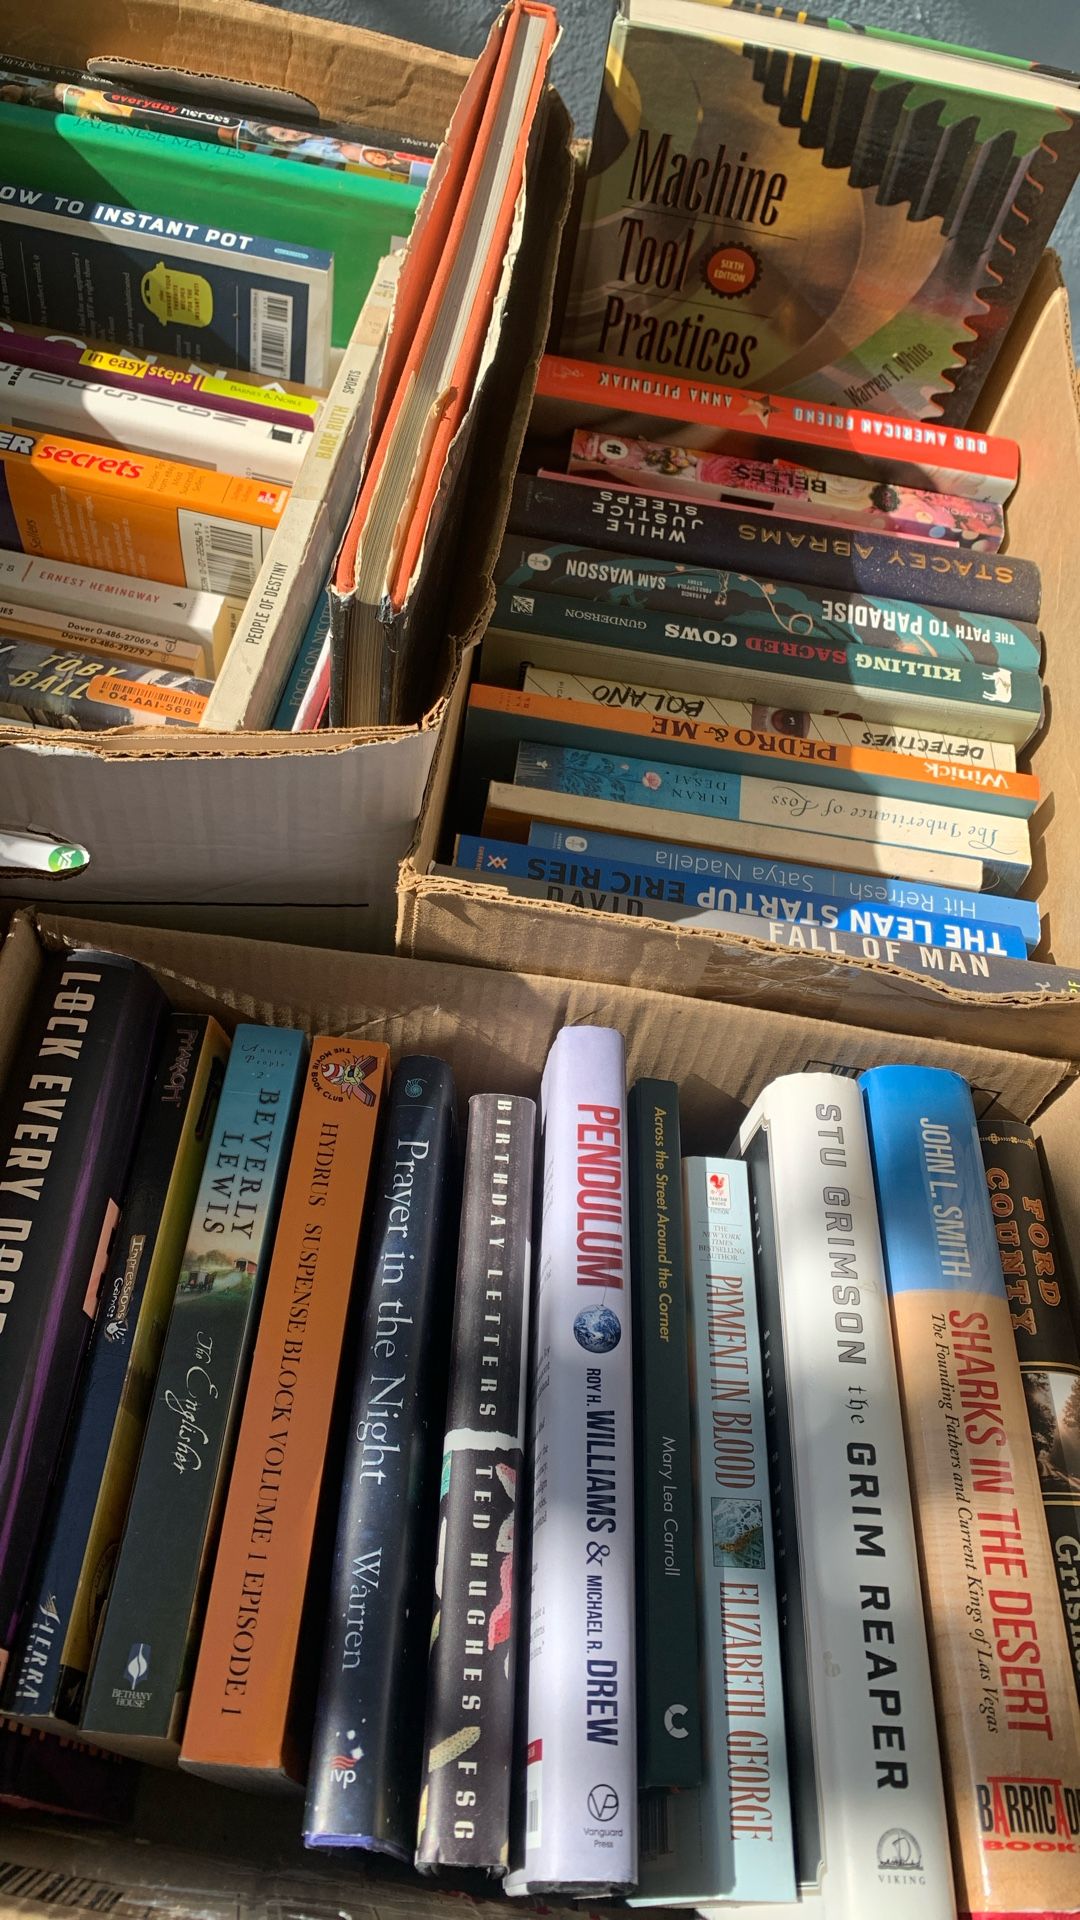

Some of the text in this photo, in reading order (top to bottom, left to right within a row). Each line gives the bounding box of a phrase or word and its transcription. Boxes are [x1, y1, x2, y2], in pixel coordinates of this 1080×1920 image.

[74, 116, 247, 160] JAPANESE MAPLES
[111, 93, 230, 124] everyday heroes
[627, 128, 788, 227] Machine
[0, 186, 253, 250] OW TO INSTANT POT
[616, 216, 695, 292] Tool
[713, 268, 746, 284] EDITION
[720, 258, 744, 272] SIXTH
[598, 294, 759, 380] Practices
[88, 352, 194, 385] in easy steps
[342, 369, 362, 395] SPORTS
[315, 405, 349, 461] BABE RUTH
[599, 372, 988, 454] OUR AMERICAN FRIEND ANNA PITONIAK
[38, 444, 145, 480] secrets
[731, 463, 826, 494] BELLES
[592, 502, 704, 530] JUSTICE
[599, 491, 698, 516] SLEEPS
[607, 519, 687, 544] WHILE
[566, 559, 667, 590] SAM WASSON
[738, 524, 1014, 584] STACEY ABRAMS
[39, 571, 161, 603] ERNEST HEMINGWAY
[245, 562, 288, 645] PEOPLE OF DESTINY
[67, 621, 160, 648] Dover 0-486-27069-6
[565, 608, 962, 683] KILLING SACRED COWS GUNDERSON
[821, 600, 1015, 645] THE PATH TO PARADISE
[9, 670, 89, 700] BALL
[38, 654, 127, 677] TOBY
[650, 715, 1009, 790] Winick PEDRO & ME
[861, 732, 985, 760] DETECTIVES
[672, 788, 728, 805] KIRAN
[675, 775, 728, 791] DESAI
[771, 786, 1018, 855] The Inheritance of Loss
[527, 858, 1007, 956] THE LEAN STARTUP ERIC RIES
[546, 885, 644, 917] DAVID
[655, 850, 976, 918] Hit Refresh Satya Nadella
[769, 922, 990, 978] FALL OF MAN
[0, 971, 101, 1201] LOCK EVERY
[244, 1055, 286, 1068] People
[202, 1131, 245, 1235] LEWIS
[230, 1087, 281, 1240] BEVERLY
[308, 1122, 340, 1208] HYDRUS
[576, 1104, 624, 1290] PENDULUM
[653, 1106, 672, 1343] Across the Street Around the Corner
[920, 1118, 972, 1278] JOHN L. SMITH
[698, 1244, 745, 1255] BESTSELLING
[707, 1253, 738, 1261] AUTHOR
[985, 1168, 1037, 1336] COUNTY
[1023, 1197, 1061, 1306] FORD
[291, 1222, 323, 1340] SUSPENSE
[272, 1340, 303, 1422] BLOCK
[342, 1138, 430, 1672] Prayer in the Night Warren
[705, 1273, 757, 1490] PAYMENT IN BLOOD
[454, 1099, 513, 1840] BIRTHDAY LETTERS TED HUGHES FSG
[814, 1103, 910, 1791] STU GRIMSON the GRIM REAPER
[250, 1430, 289, 1544] VOLUME
[658, 1436, 681, 1578] Mary Lea Carroll
[930, 1313, 999, 1734] The Founding Fathers and Current Kings of Las Vegas
[948, 1309, 1053, 1741] SHARKS IN THE DESERT
[586, 1367, 618, 1746] ROY H. WILLIAMS & MICHAEL R. DREW
[225, 1569, 264, 1697] EPISODE
[111, 1688, 152, 1701] BETHANY
[116, 1698, 145, 1708] HOUSE
[719, 1580, 774, 1841] ELIZABETH GEORGE
[330, 1767, 357, 1789] ivp
[583, 1826, 624, 1839] Vanguard
[594, 1839, 614, 1849] Press
[983, 1840, 1080, 1853] BOOK
[877, 1875, 927, 1885] VIKING
